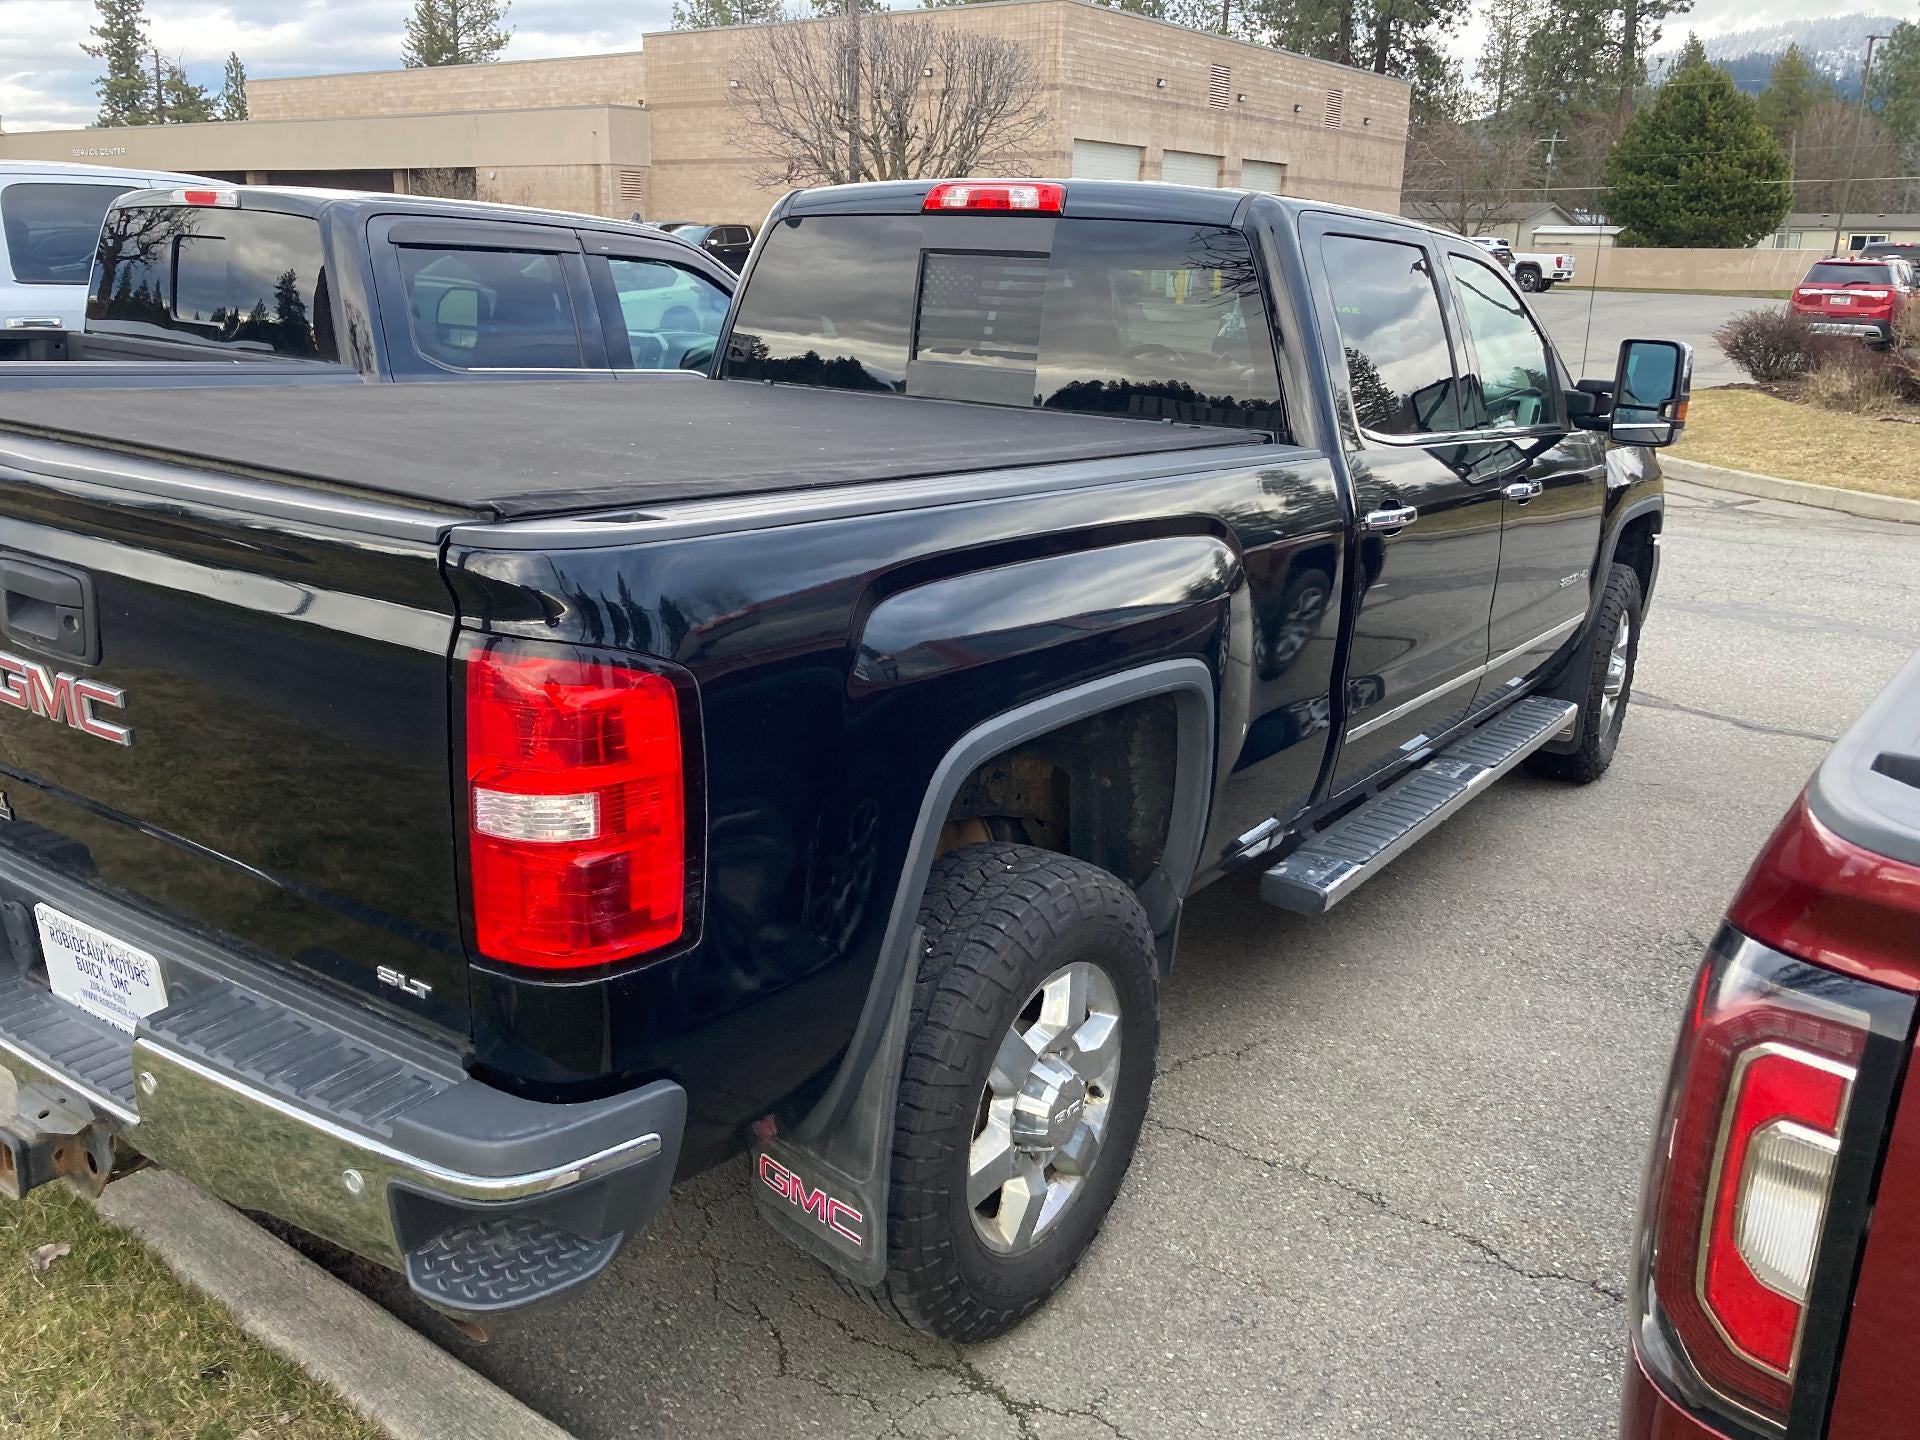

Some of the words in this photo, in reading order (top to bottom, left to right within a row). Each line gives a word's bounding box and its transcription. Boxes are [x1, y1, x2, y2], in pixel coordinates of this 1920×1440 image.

[72, 147, 99, 157] SERVICE
[100, 147, 126, 157] CENTER
[49, 925, 107, 967] ROBIDEAUX
[108, 954, 150, 987] MOTORS
[75, 955, 105, 983] BUICK
[110, 972, 132, 995] GMC
[376, 965, 433, 1000] SLT
[760, 1153, 863, 1246] GMC
